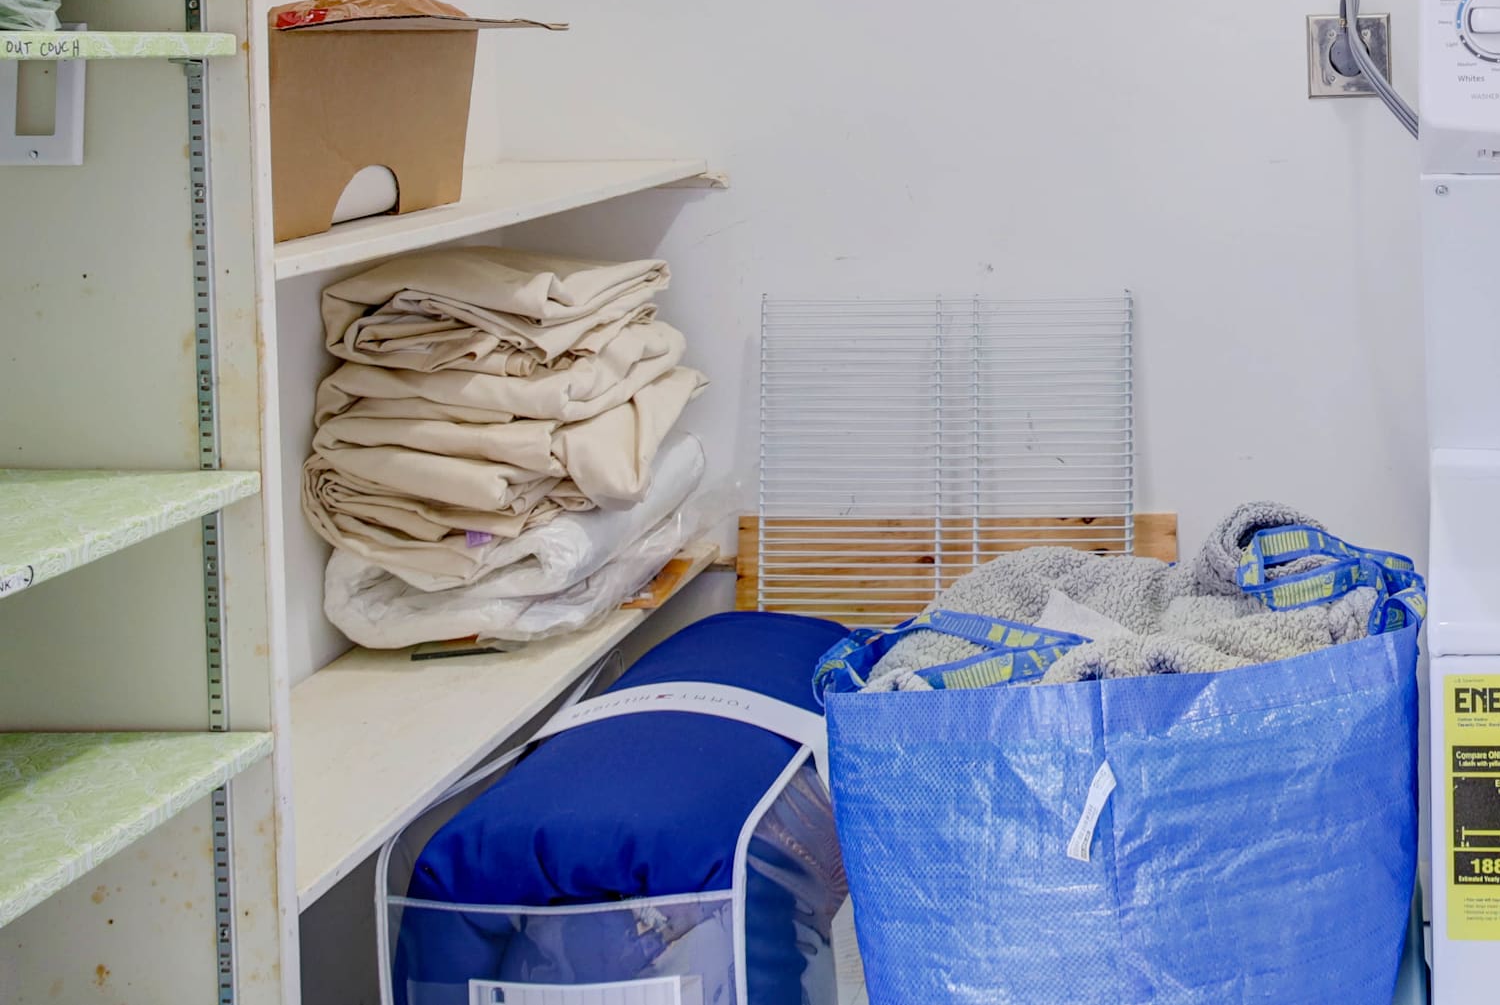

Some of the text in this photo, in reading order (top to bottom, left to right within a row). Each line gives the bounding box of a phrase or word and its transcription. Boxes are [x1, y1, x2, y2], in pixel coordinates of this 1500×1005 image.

[6, 39, 80, 57] OUT COUCH
[1458, 75, 1485, 83] Whites
[572, 694, 752, 718] TOMMY HILFIGER
[1456, 751, 1487, 762] Compare
[1484, 875, 1500, 884] Yearly
